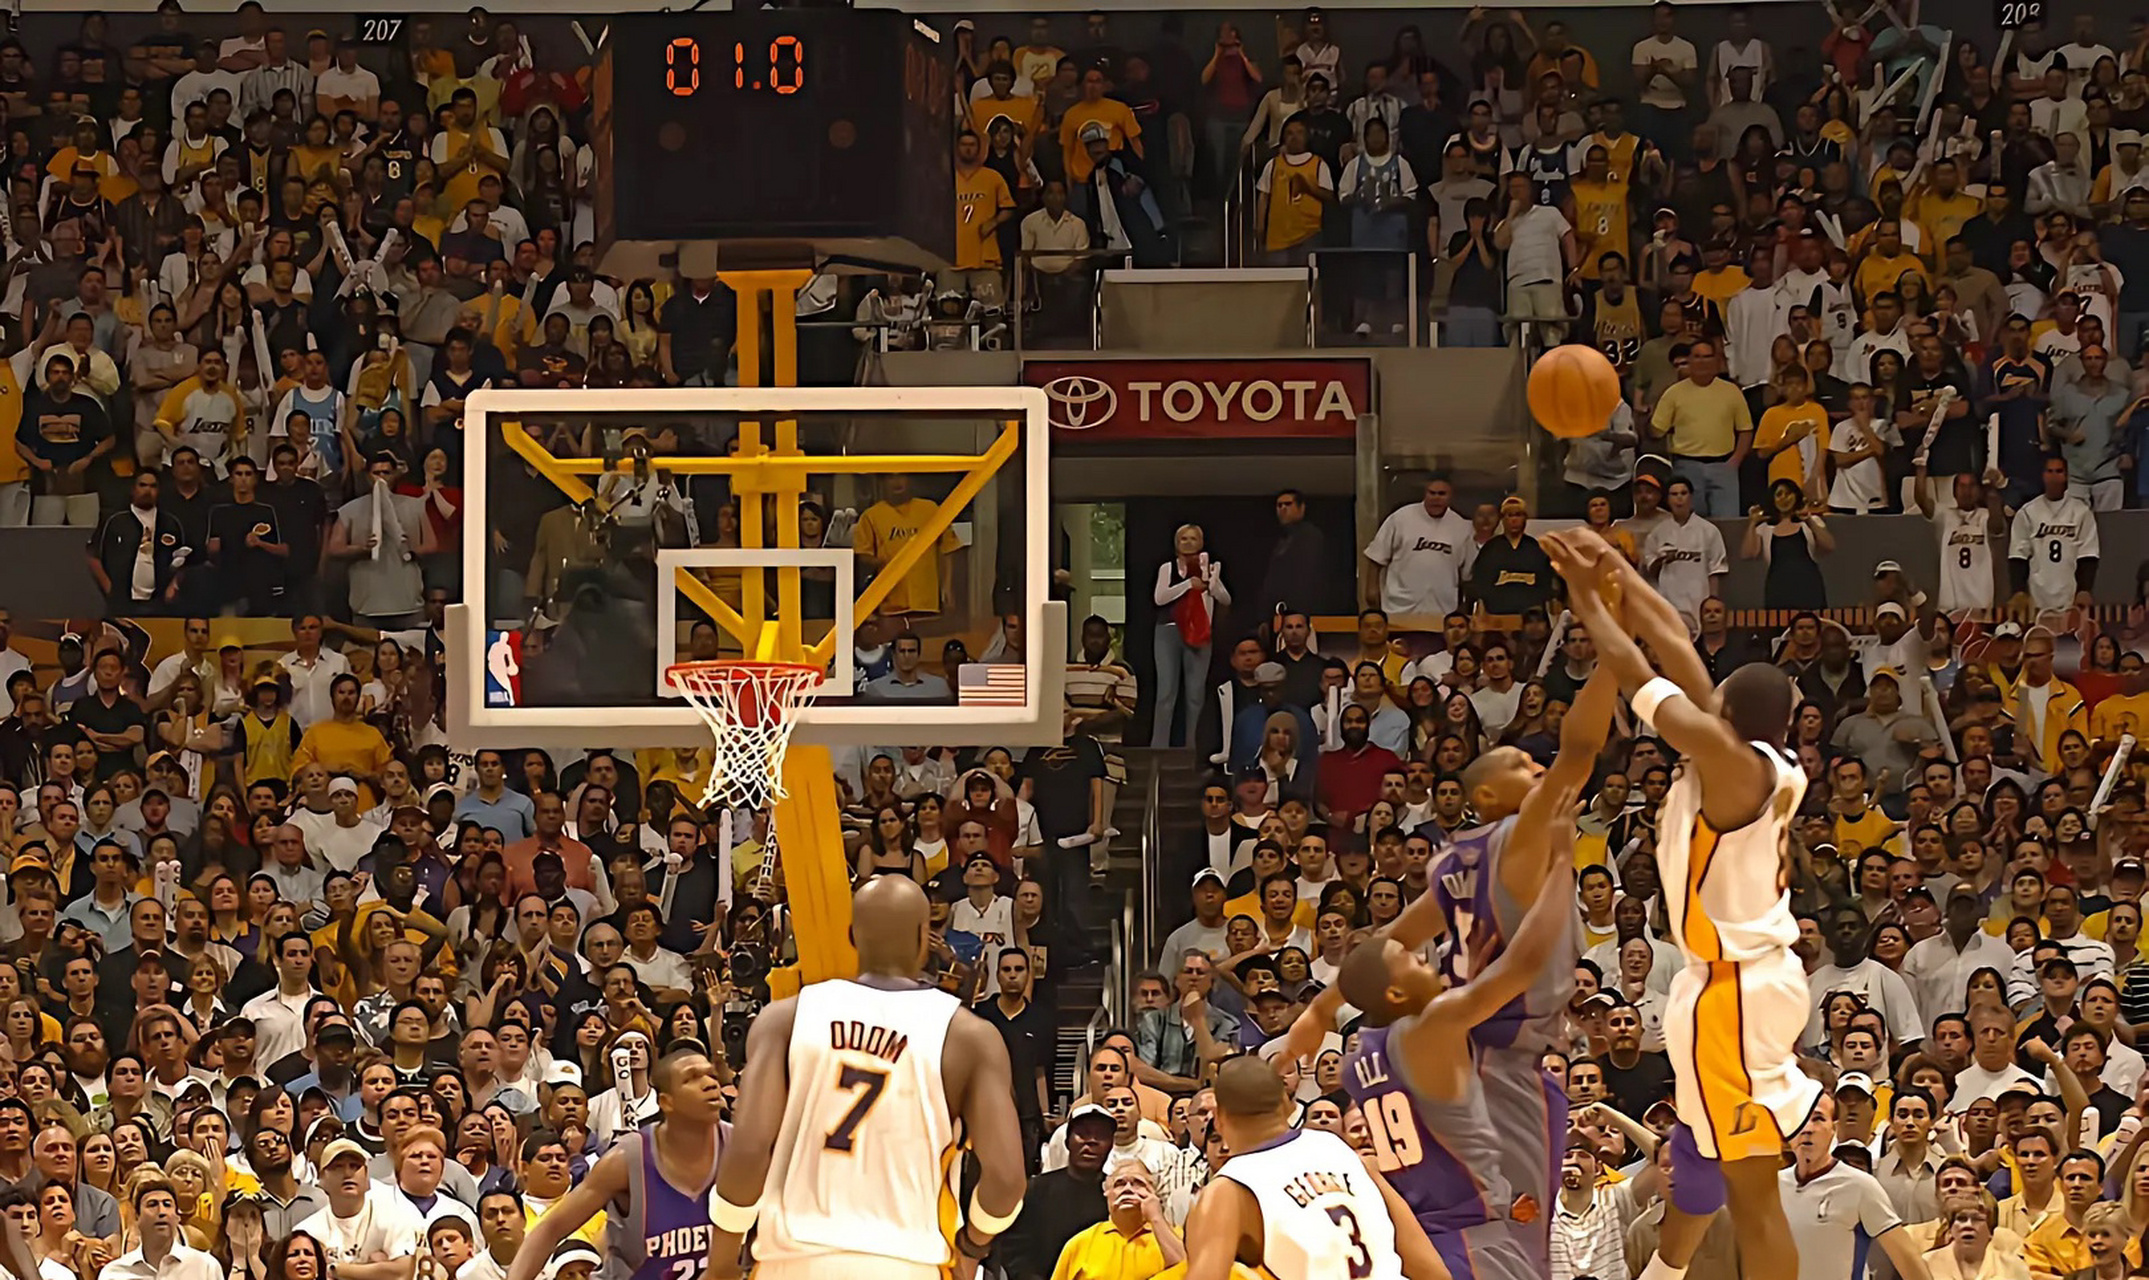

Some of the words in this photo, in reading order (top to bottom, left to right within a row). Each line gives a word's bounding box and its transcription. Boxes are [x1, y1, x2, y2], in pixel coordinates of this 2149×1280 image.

[363, 20, 402, 42] 207
[1597, 216, 1608, 235] 8
[1128, 379, 1356, 422] TOYOTA
[1959, 547, 1971, 569] 8
[2049, 539, 2062, 563] 8
[831, 1020, 908, 1064] ODOM
[824, 1063, 891, 1155] 7
[1363, 1090, 1423, 1172] 19
[1323, 1204, 1373, 1280] 3
